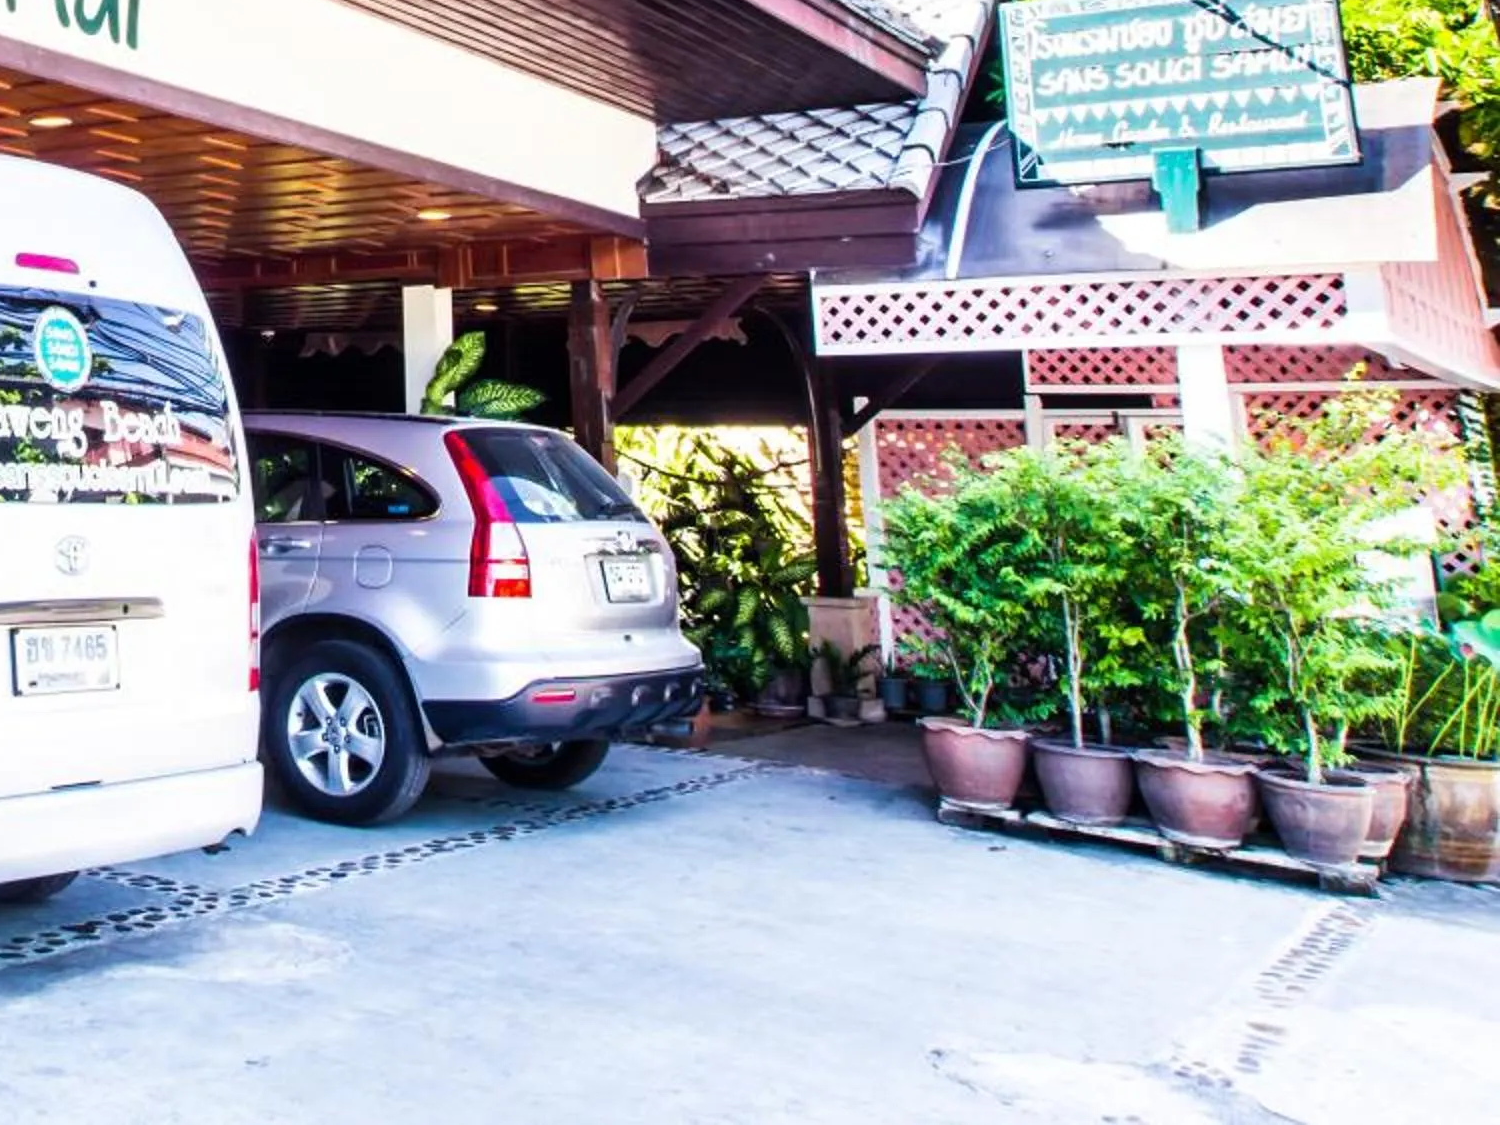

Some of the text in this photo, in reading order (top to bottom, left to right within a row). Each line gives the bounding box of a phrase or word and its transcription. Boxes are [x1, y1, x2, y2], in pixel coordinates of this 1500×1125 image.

[1036, 66, 1108, 97] SANS
[1113, 53, 1202, 90] SOUCI
[100, 398, 182, 445] Beach
